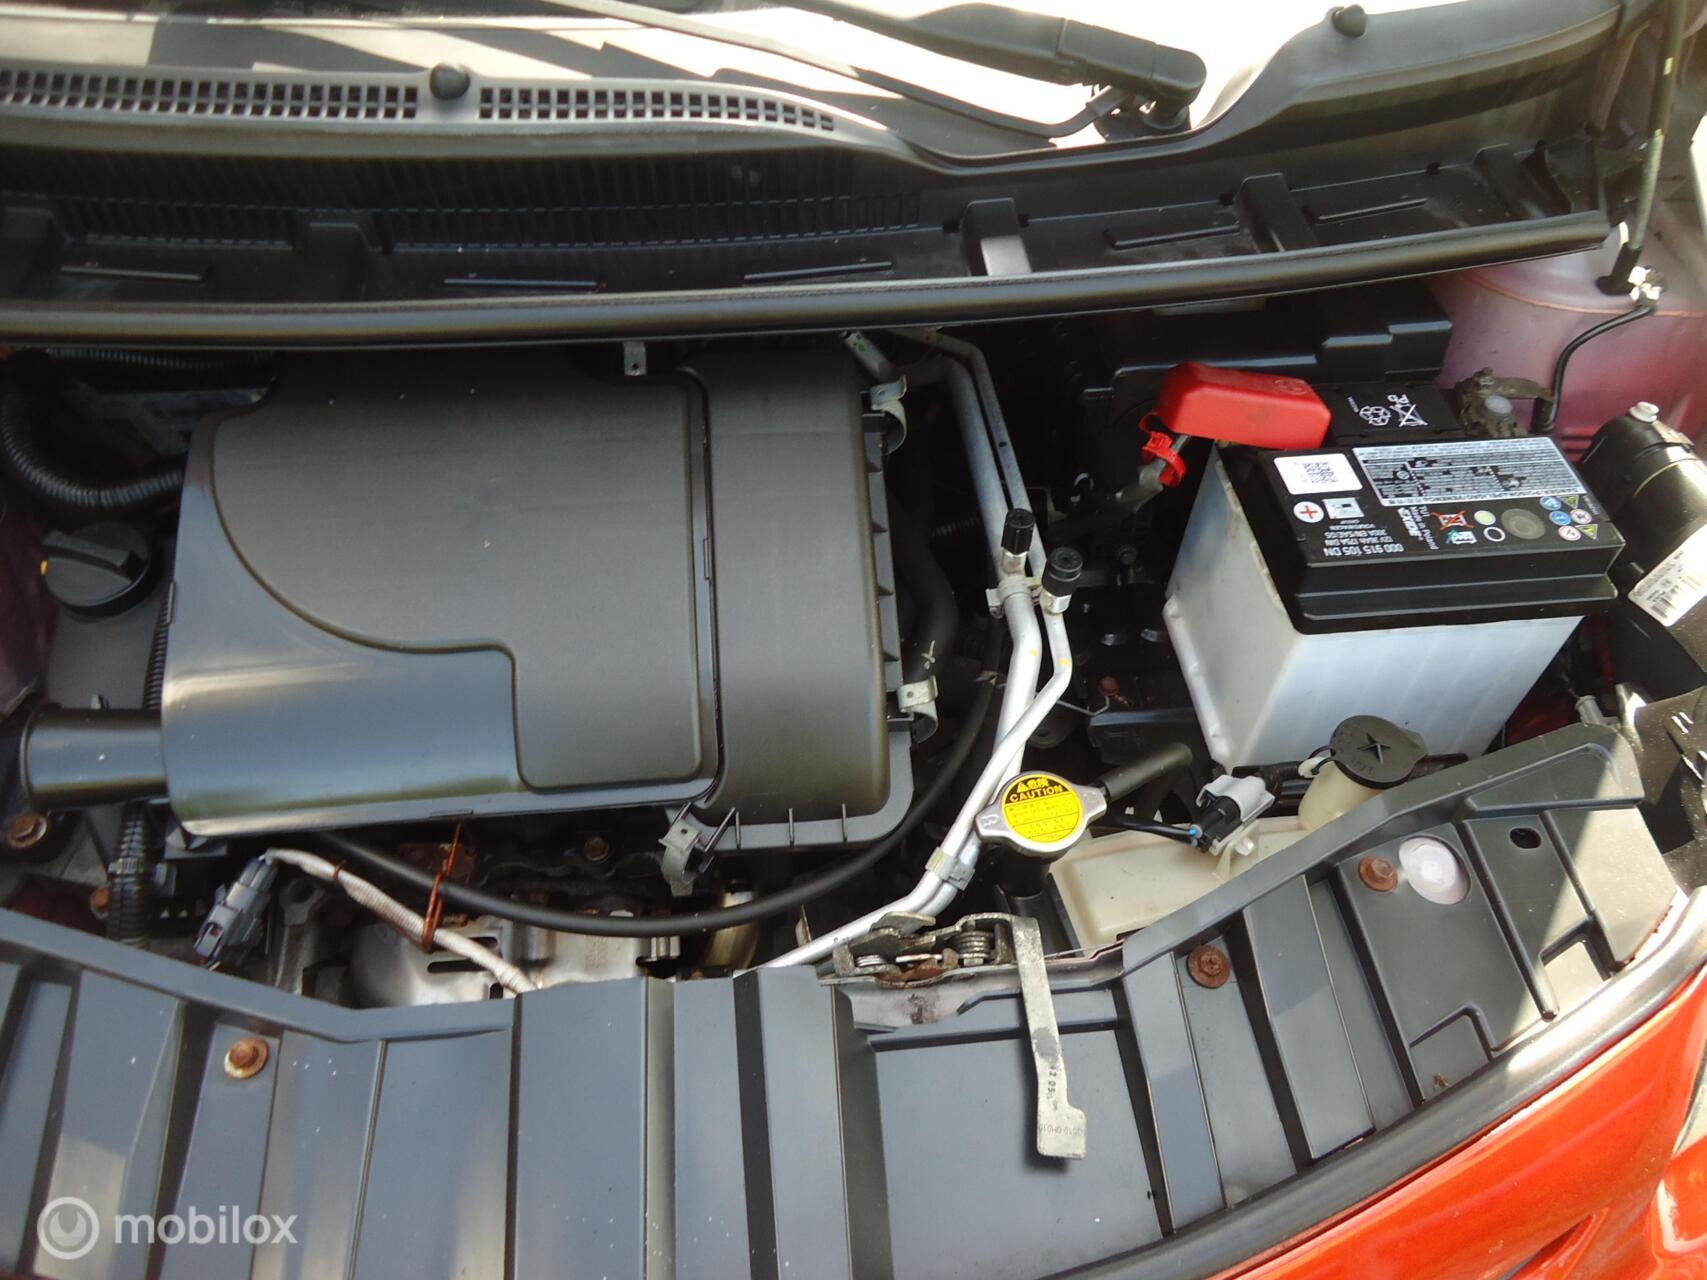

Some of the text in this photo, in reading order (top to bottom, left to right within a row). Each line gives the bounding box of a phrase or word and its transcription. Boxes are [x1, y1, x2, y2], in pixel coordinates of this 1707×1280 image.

[1422, 529, 1440, 549] Poland
[1323, 543, 1405, 557] 000 915 105 DN
[1010, 785, 1063, 802] CAUTION
